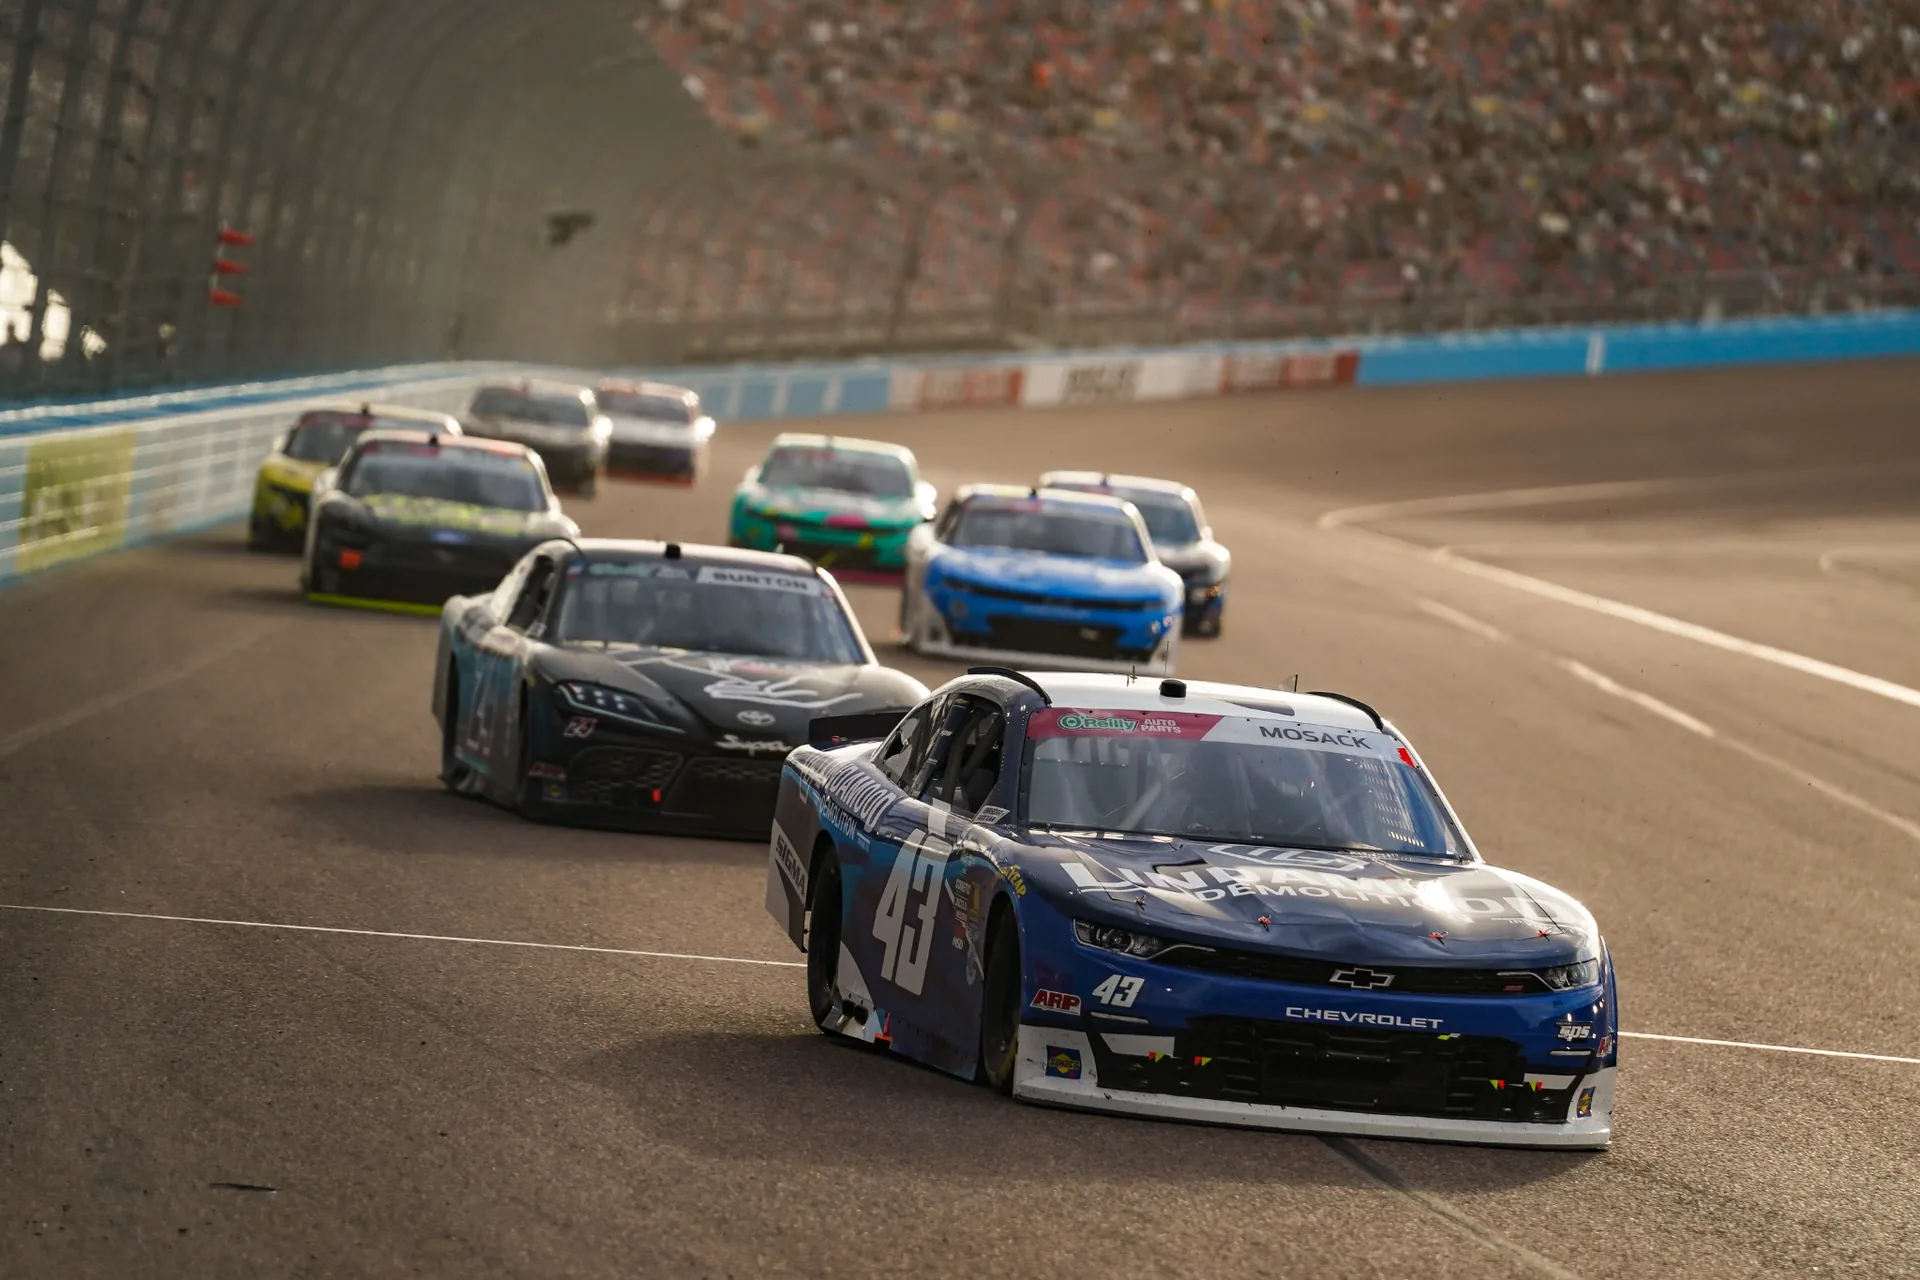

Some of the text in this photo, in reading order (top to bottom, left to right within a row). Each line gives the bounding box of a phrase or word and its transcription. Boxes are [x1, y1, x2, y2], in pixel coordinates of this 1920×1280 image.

[711, 572, 809, 590] BURTON
[1058, 714, 1138, 733] O'Reilly
[1141, 725, 1181, 734] PARTS
[1144, 718, 1176, 727] AUTO
[714, 733, 793, 757] Supra
[1259, 726, 1372, 750] MOSACK
[819, 794, 858, 841] DEMOLITION
[775, 834, 805, 895] SIGMA
[1059, 862, 1562, 924] LINDAMOD
[1195, 884, 1474, 923] DEMOLITI
[872, 828, 952, 996] 43
[1031, 990, 1080, 1011] ARP
[1091, 973, 1146, 1008] 43
[1285, 1006, 1444, 1029] CHEVROLET
[1048, 1058, 1081, 1069] SUNOCO
